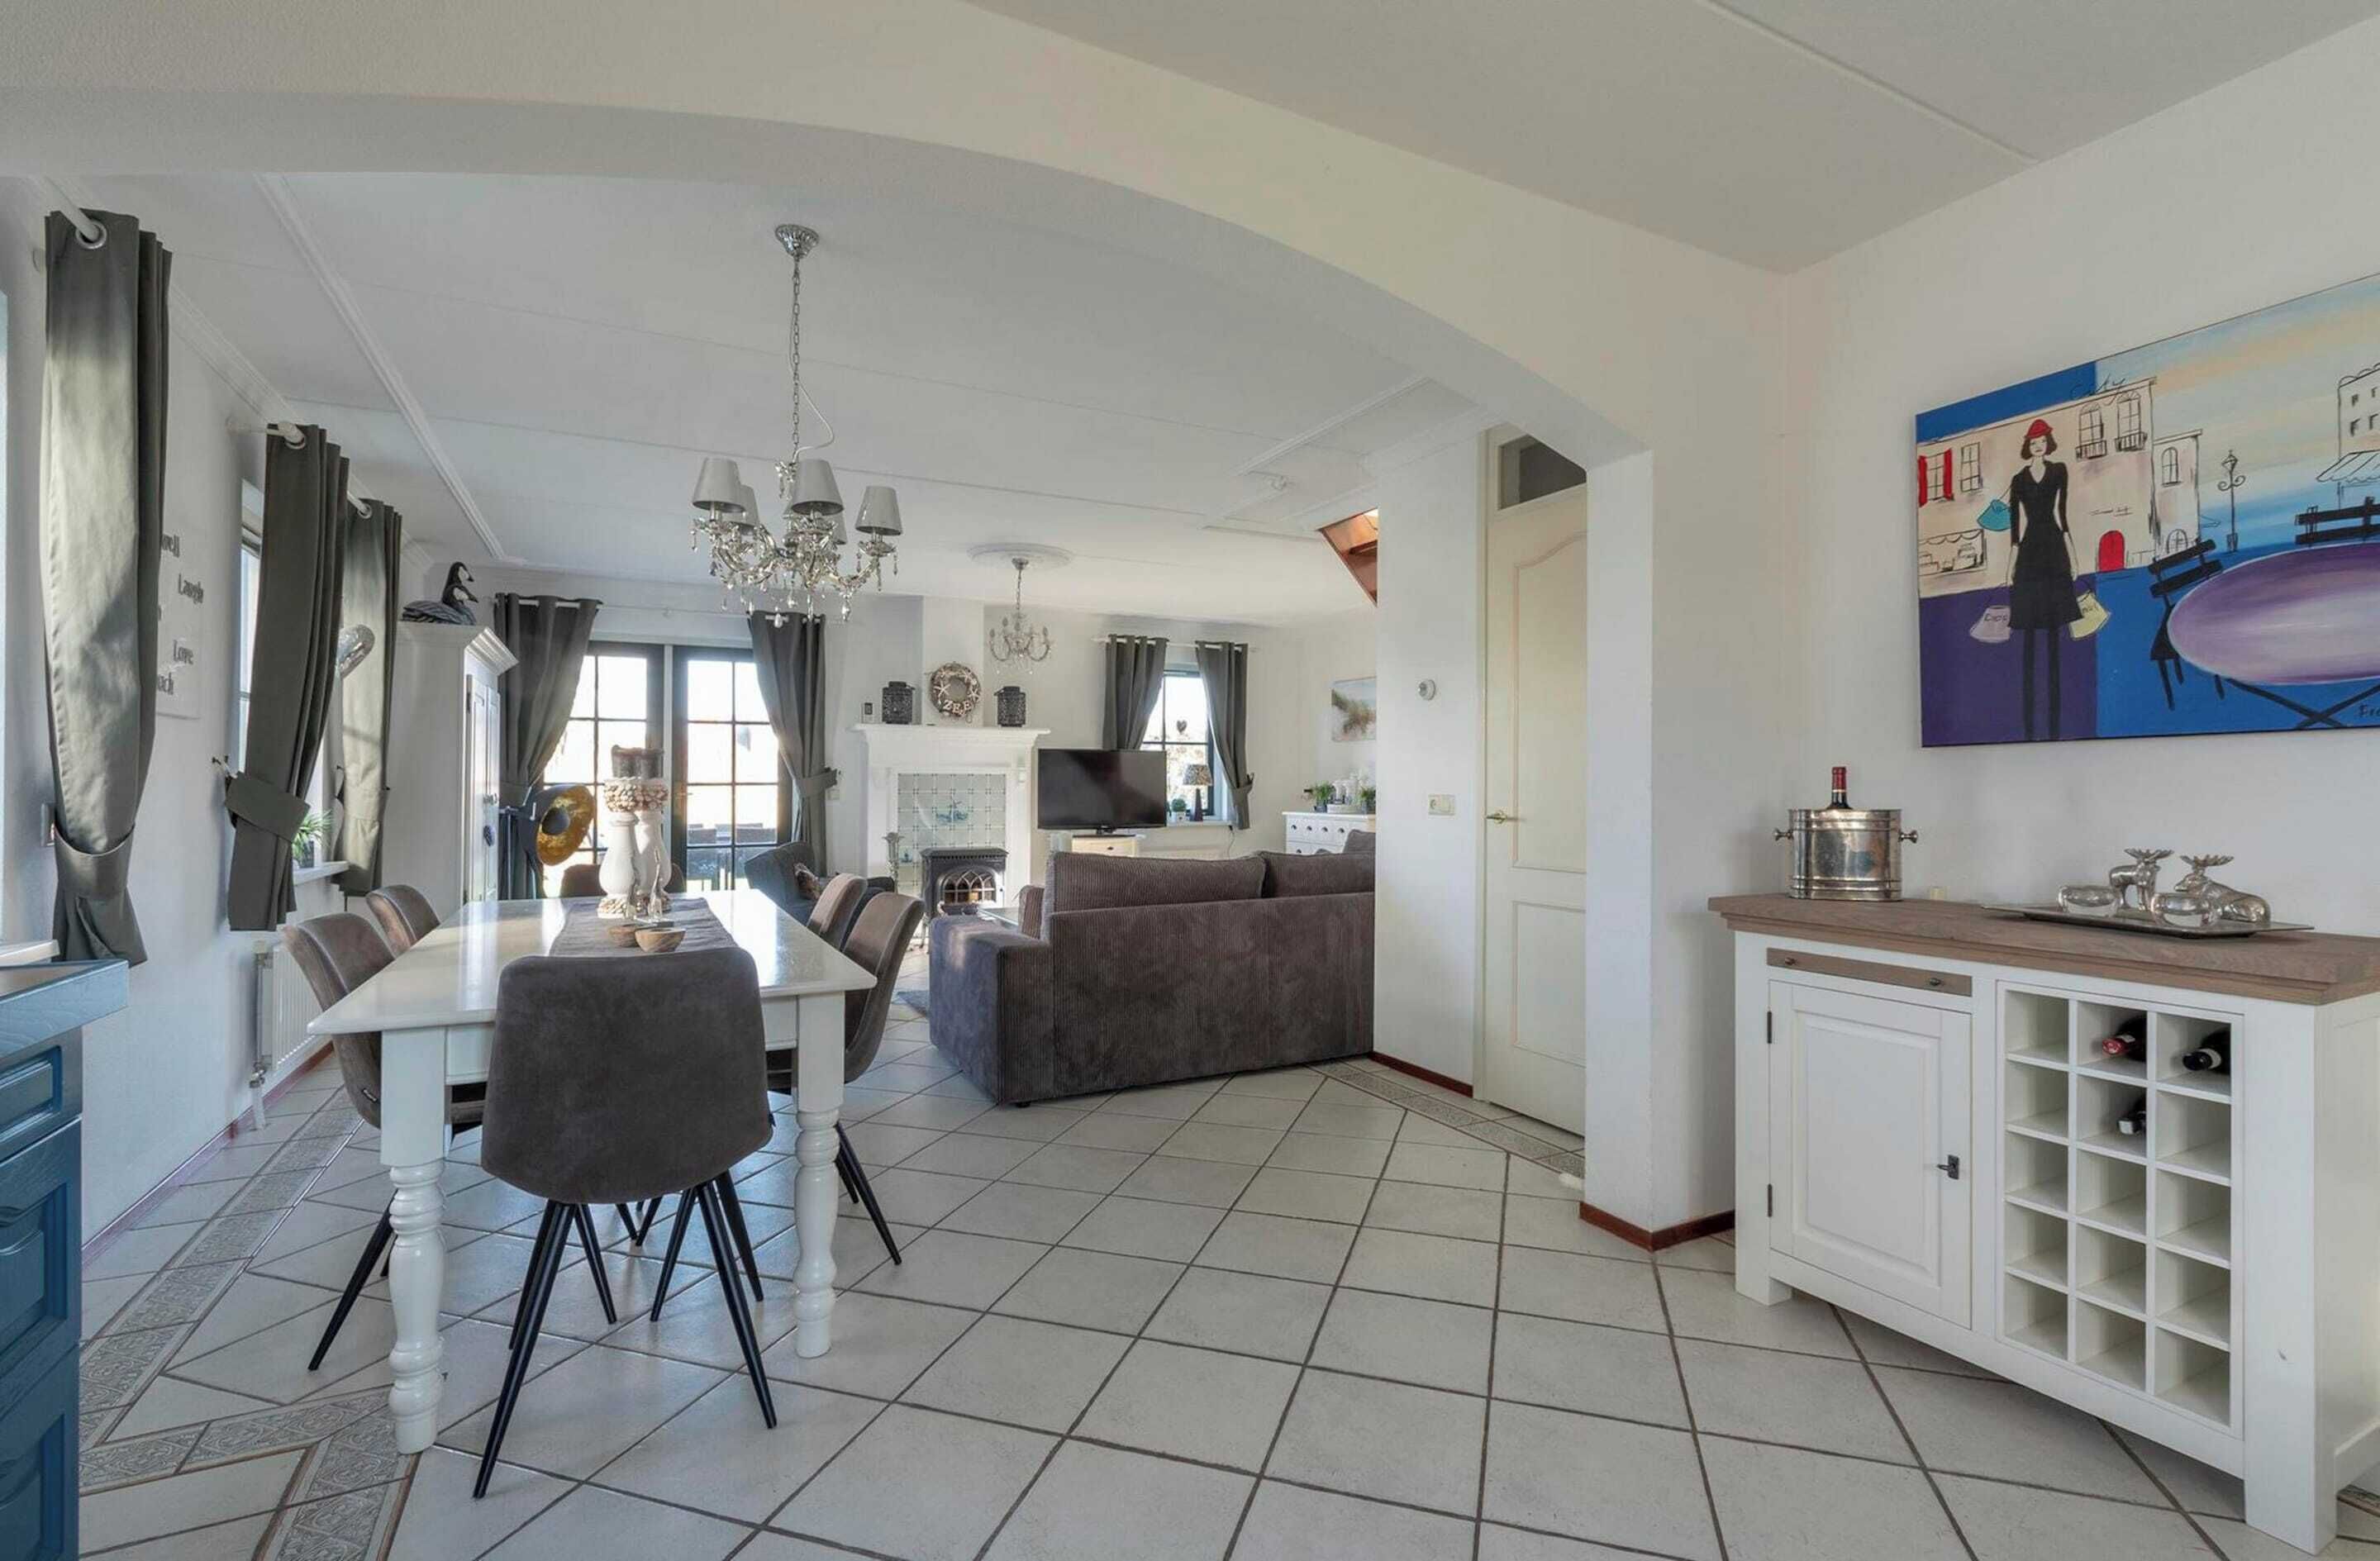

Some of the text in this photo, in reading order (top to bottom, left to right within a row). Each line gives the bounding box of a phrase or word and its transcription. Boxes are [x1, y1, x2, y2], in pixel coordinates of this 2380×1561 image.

[178, 573, 204, 605] Laugh
[173, 639, 194, 664] Love
[158, 672, 174, 695] uch
